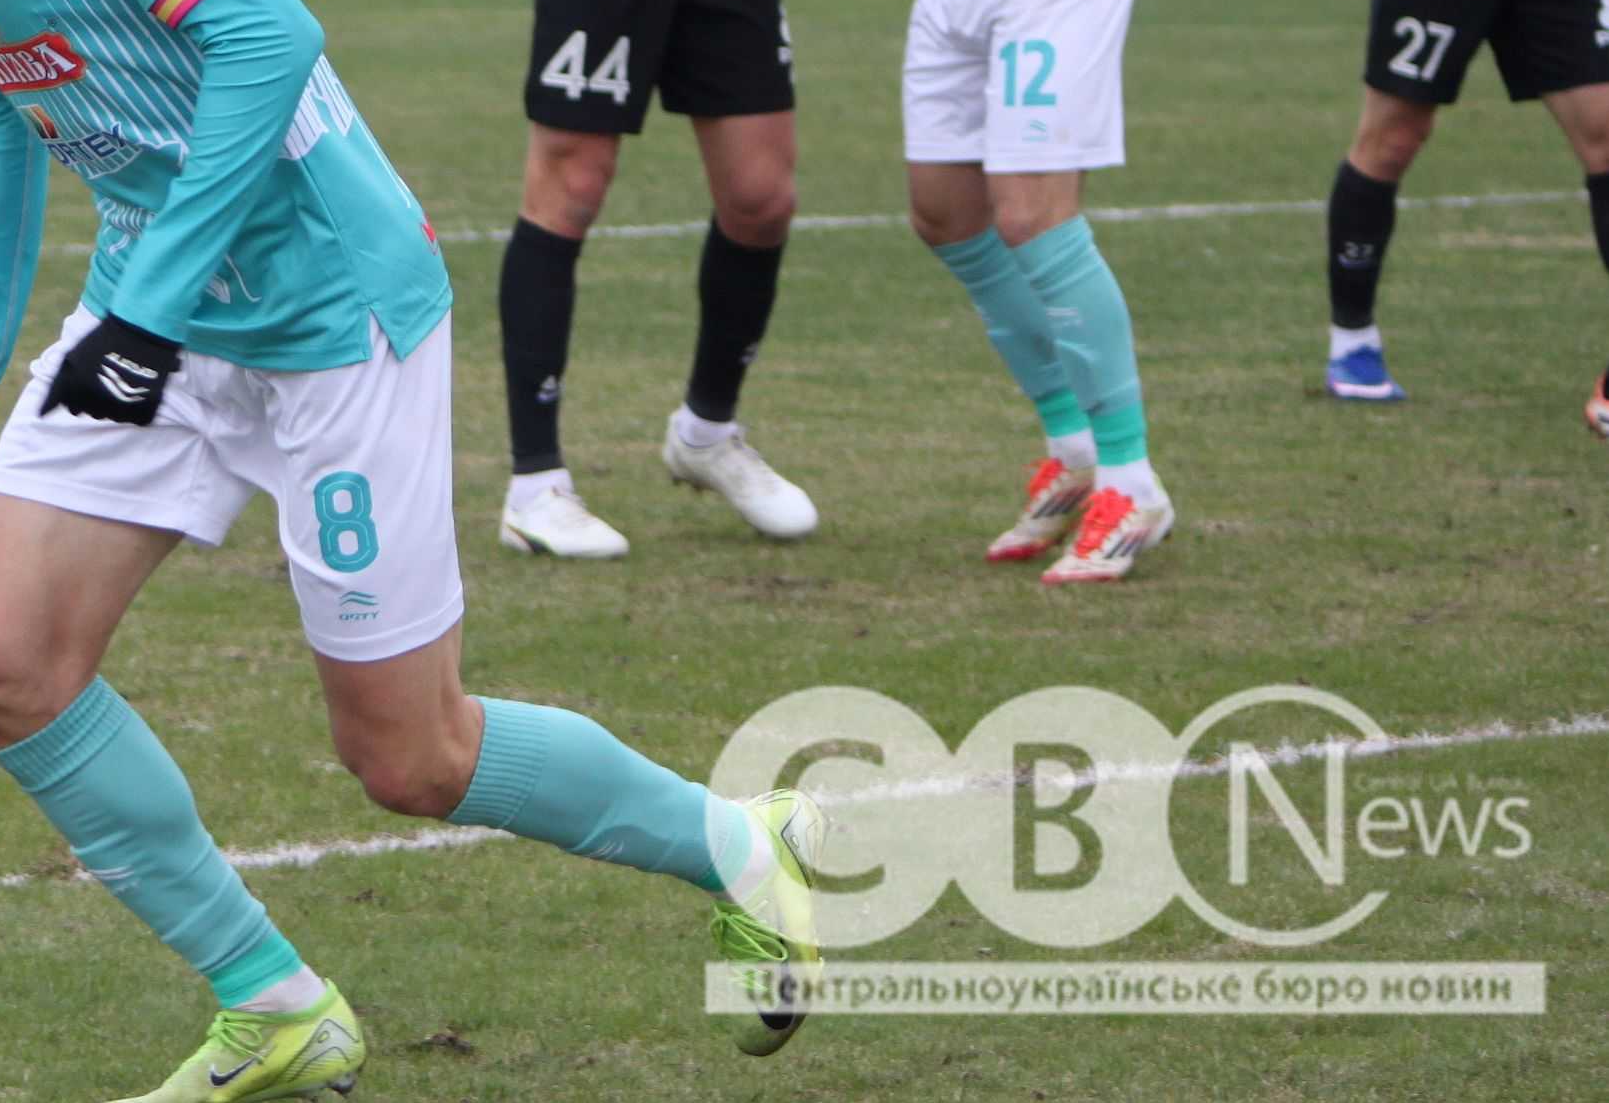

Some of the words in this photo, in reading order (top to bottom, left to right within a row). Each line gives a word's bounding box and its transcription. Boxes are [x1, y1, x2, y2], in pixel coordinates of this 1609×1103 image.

[540, 30, 632, 104] 44
[998, 39, 1058, 108] 12
[1388, 16, 1457, 82] 27
[313, 471, 380, 573] 8
